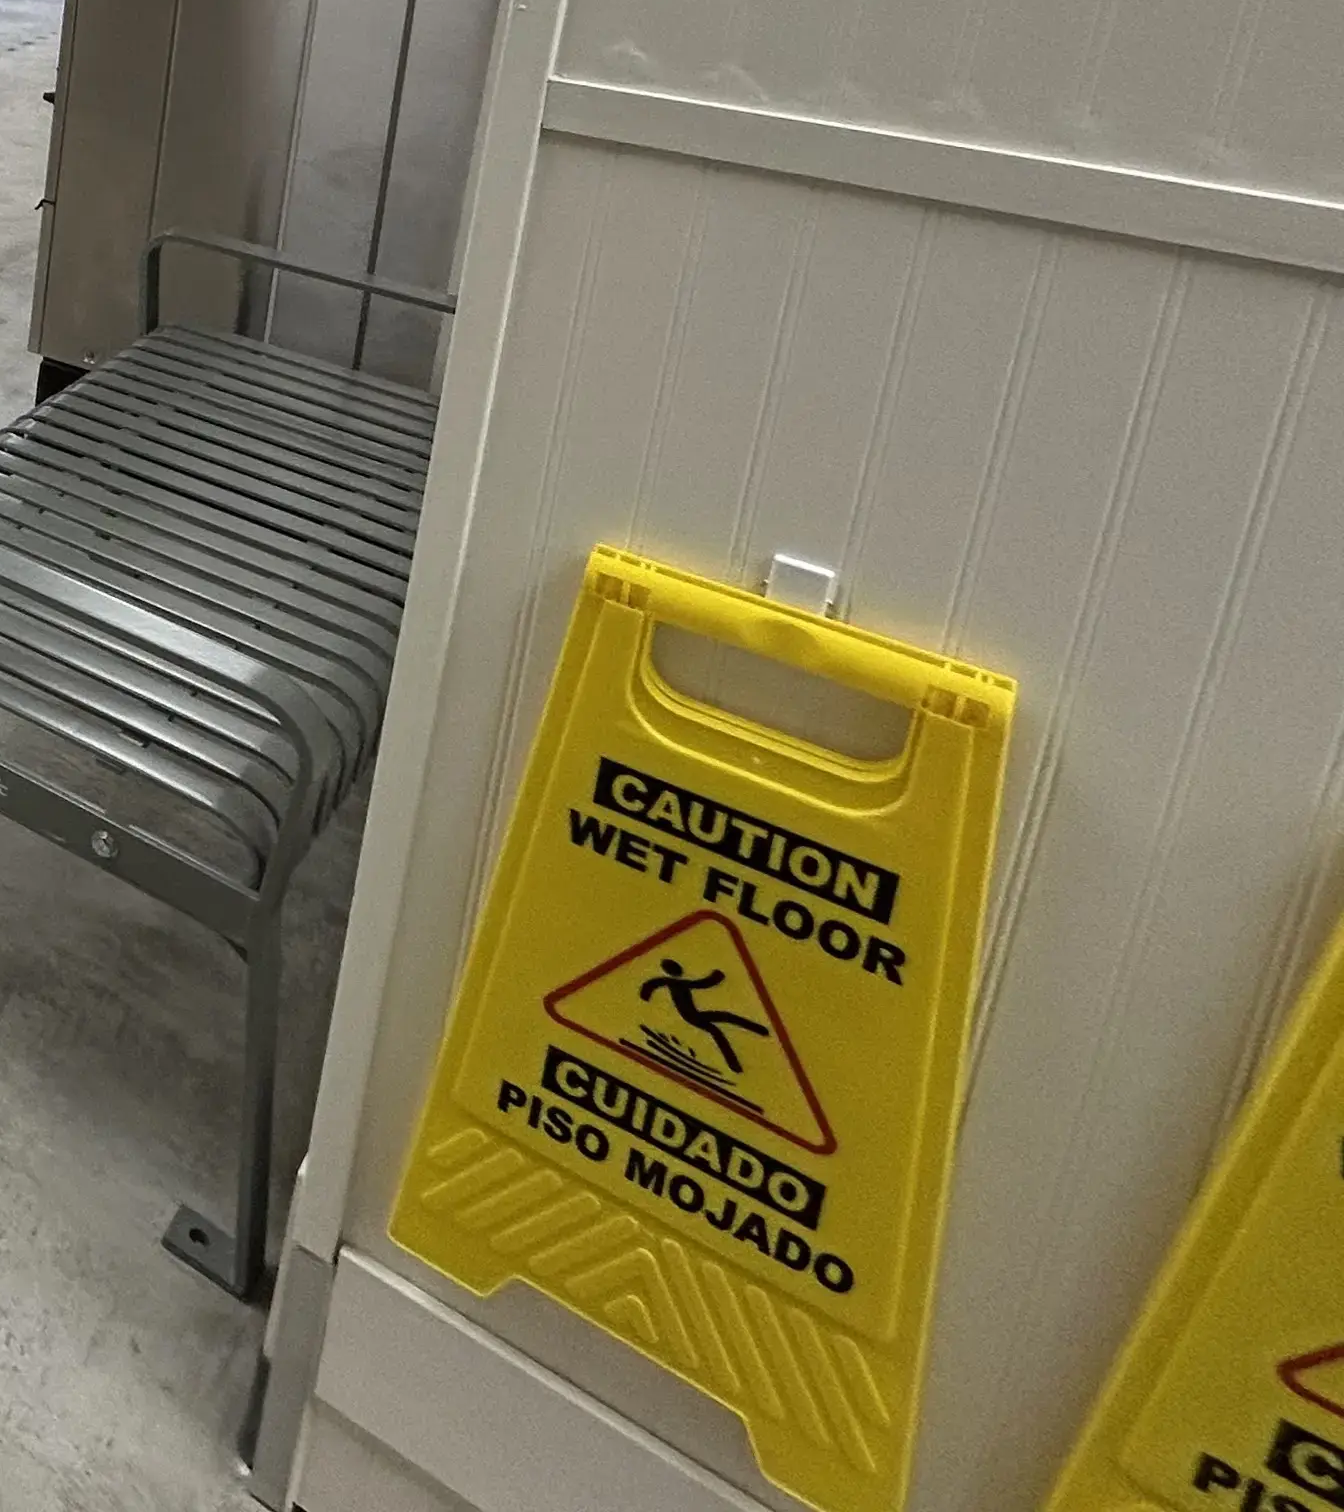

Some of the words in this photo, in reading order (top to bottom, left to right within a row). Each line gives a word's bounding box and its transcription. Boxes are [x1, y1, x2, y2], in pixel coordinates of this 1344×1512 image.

[568, 808, 689, 884] WET
[611, 773, 881, 911] CAUTION
[702, 865, 907, 986] FLOOR
[497, 1078, 610, 1163] PISO
[554, 1060, 810, 1212] CUIDADO
[623, 1146, 855, 1295] MOJADO
